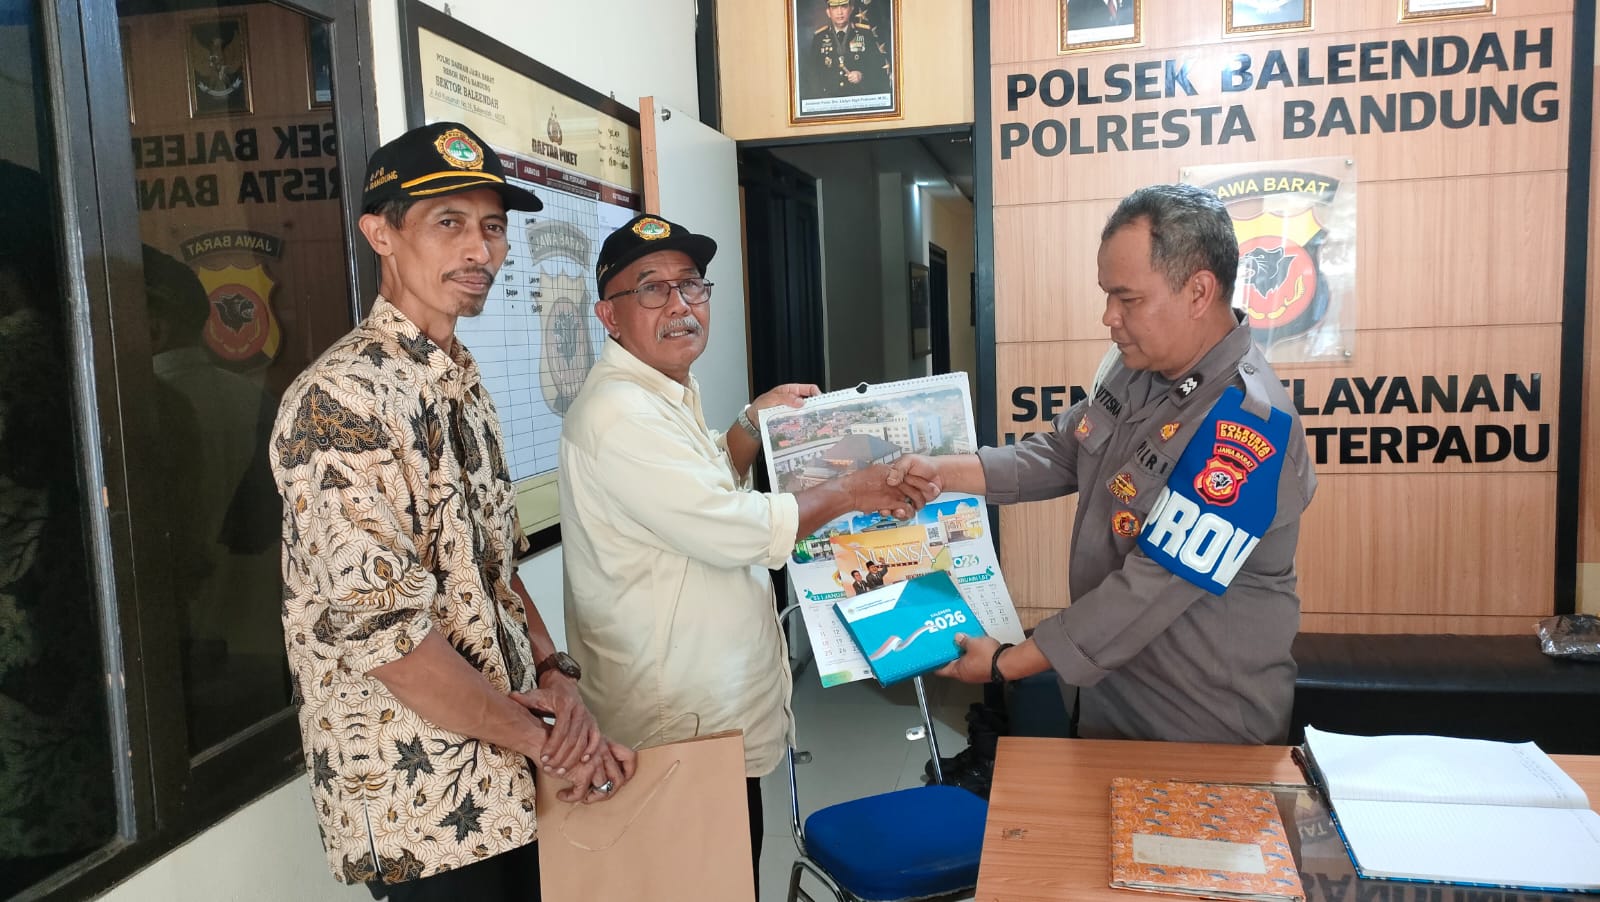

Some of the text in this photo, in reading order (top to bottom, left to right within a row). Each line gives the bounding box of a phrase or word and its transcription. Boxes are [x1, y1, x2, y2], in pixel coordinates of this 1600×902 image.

[1007, 27, 1553, 112] POLSEK BALEENDAH
[435, 75, 462, 95] SEKTOR
[462, 86, 499, 110] BALEENDAH
[1000, 81, 1559, 160] POLRESTA BANDUNG
[532, 138, 559, 161] DAFTAR
[559, 148, 578, 166] PIKET
[1216, 177, 1330, 199] AWA BARAT
[535, 232, 585, 252] JAWA BARAT
[1095, 385, 1122, 419] UTISNA
[1280, 373, 1542, 416] LAYANAN
[1220, 423, 1271, 454] POLRESTA
[1220, 430, 1266, 458] BANDUNG
[1305, 424, 1550, 465] TERPADU
[1217, 446, 1254, 468] JAWA BARAT
[1141, 486, 1260, 588] PROV
[855, 541, 936, 570] NUANSA
[953, 555, 979, 569] 026
[924, 610, 966, 634] 2026
